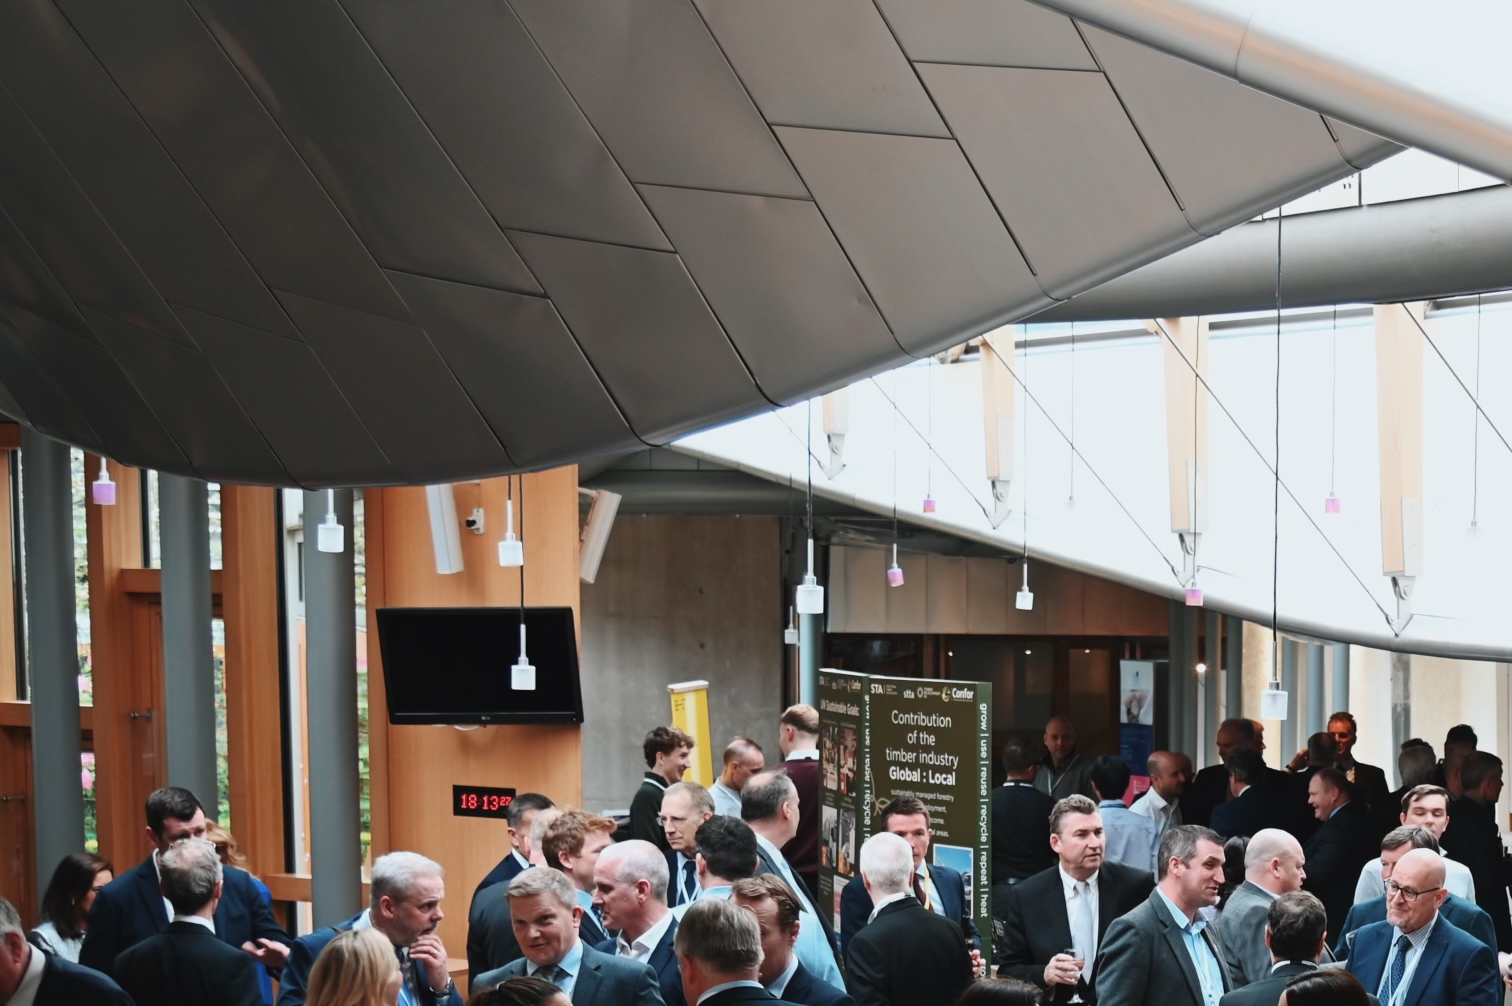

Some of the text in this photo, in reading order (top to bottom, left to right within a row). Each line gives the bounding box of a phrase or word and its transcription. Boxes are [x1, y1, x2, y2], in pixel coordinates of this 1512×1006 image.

[871, 684, 884, 694] STA
[952, 688, 974, 699] Confor
[892, 710, 952, 728] Contribution
[980, 704, 988, 730] grow
[907, 730, 936, 746] of the
[886, 748, 958, 770] timber industry
[980, 740, 988, 758] use
[889, 766, 920, 782] Global
[928, 770, 956, 786] Local
[980, 767, 988, 796] reuse
[979, 805, 988, 842] recycle
[980, 851, 988, 886] repeat
[980, 895, 989, 918] heat
